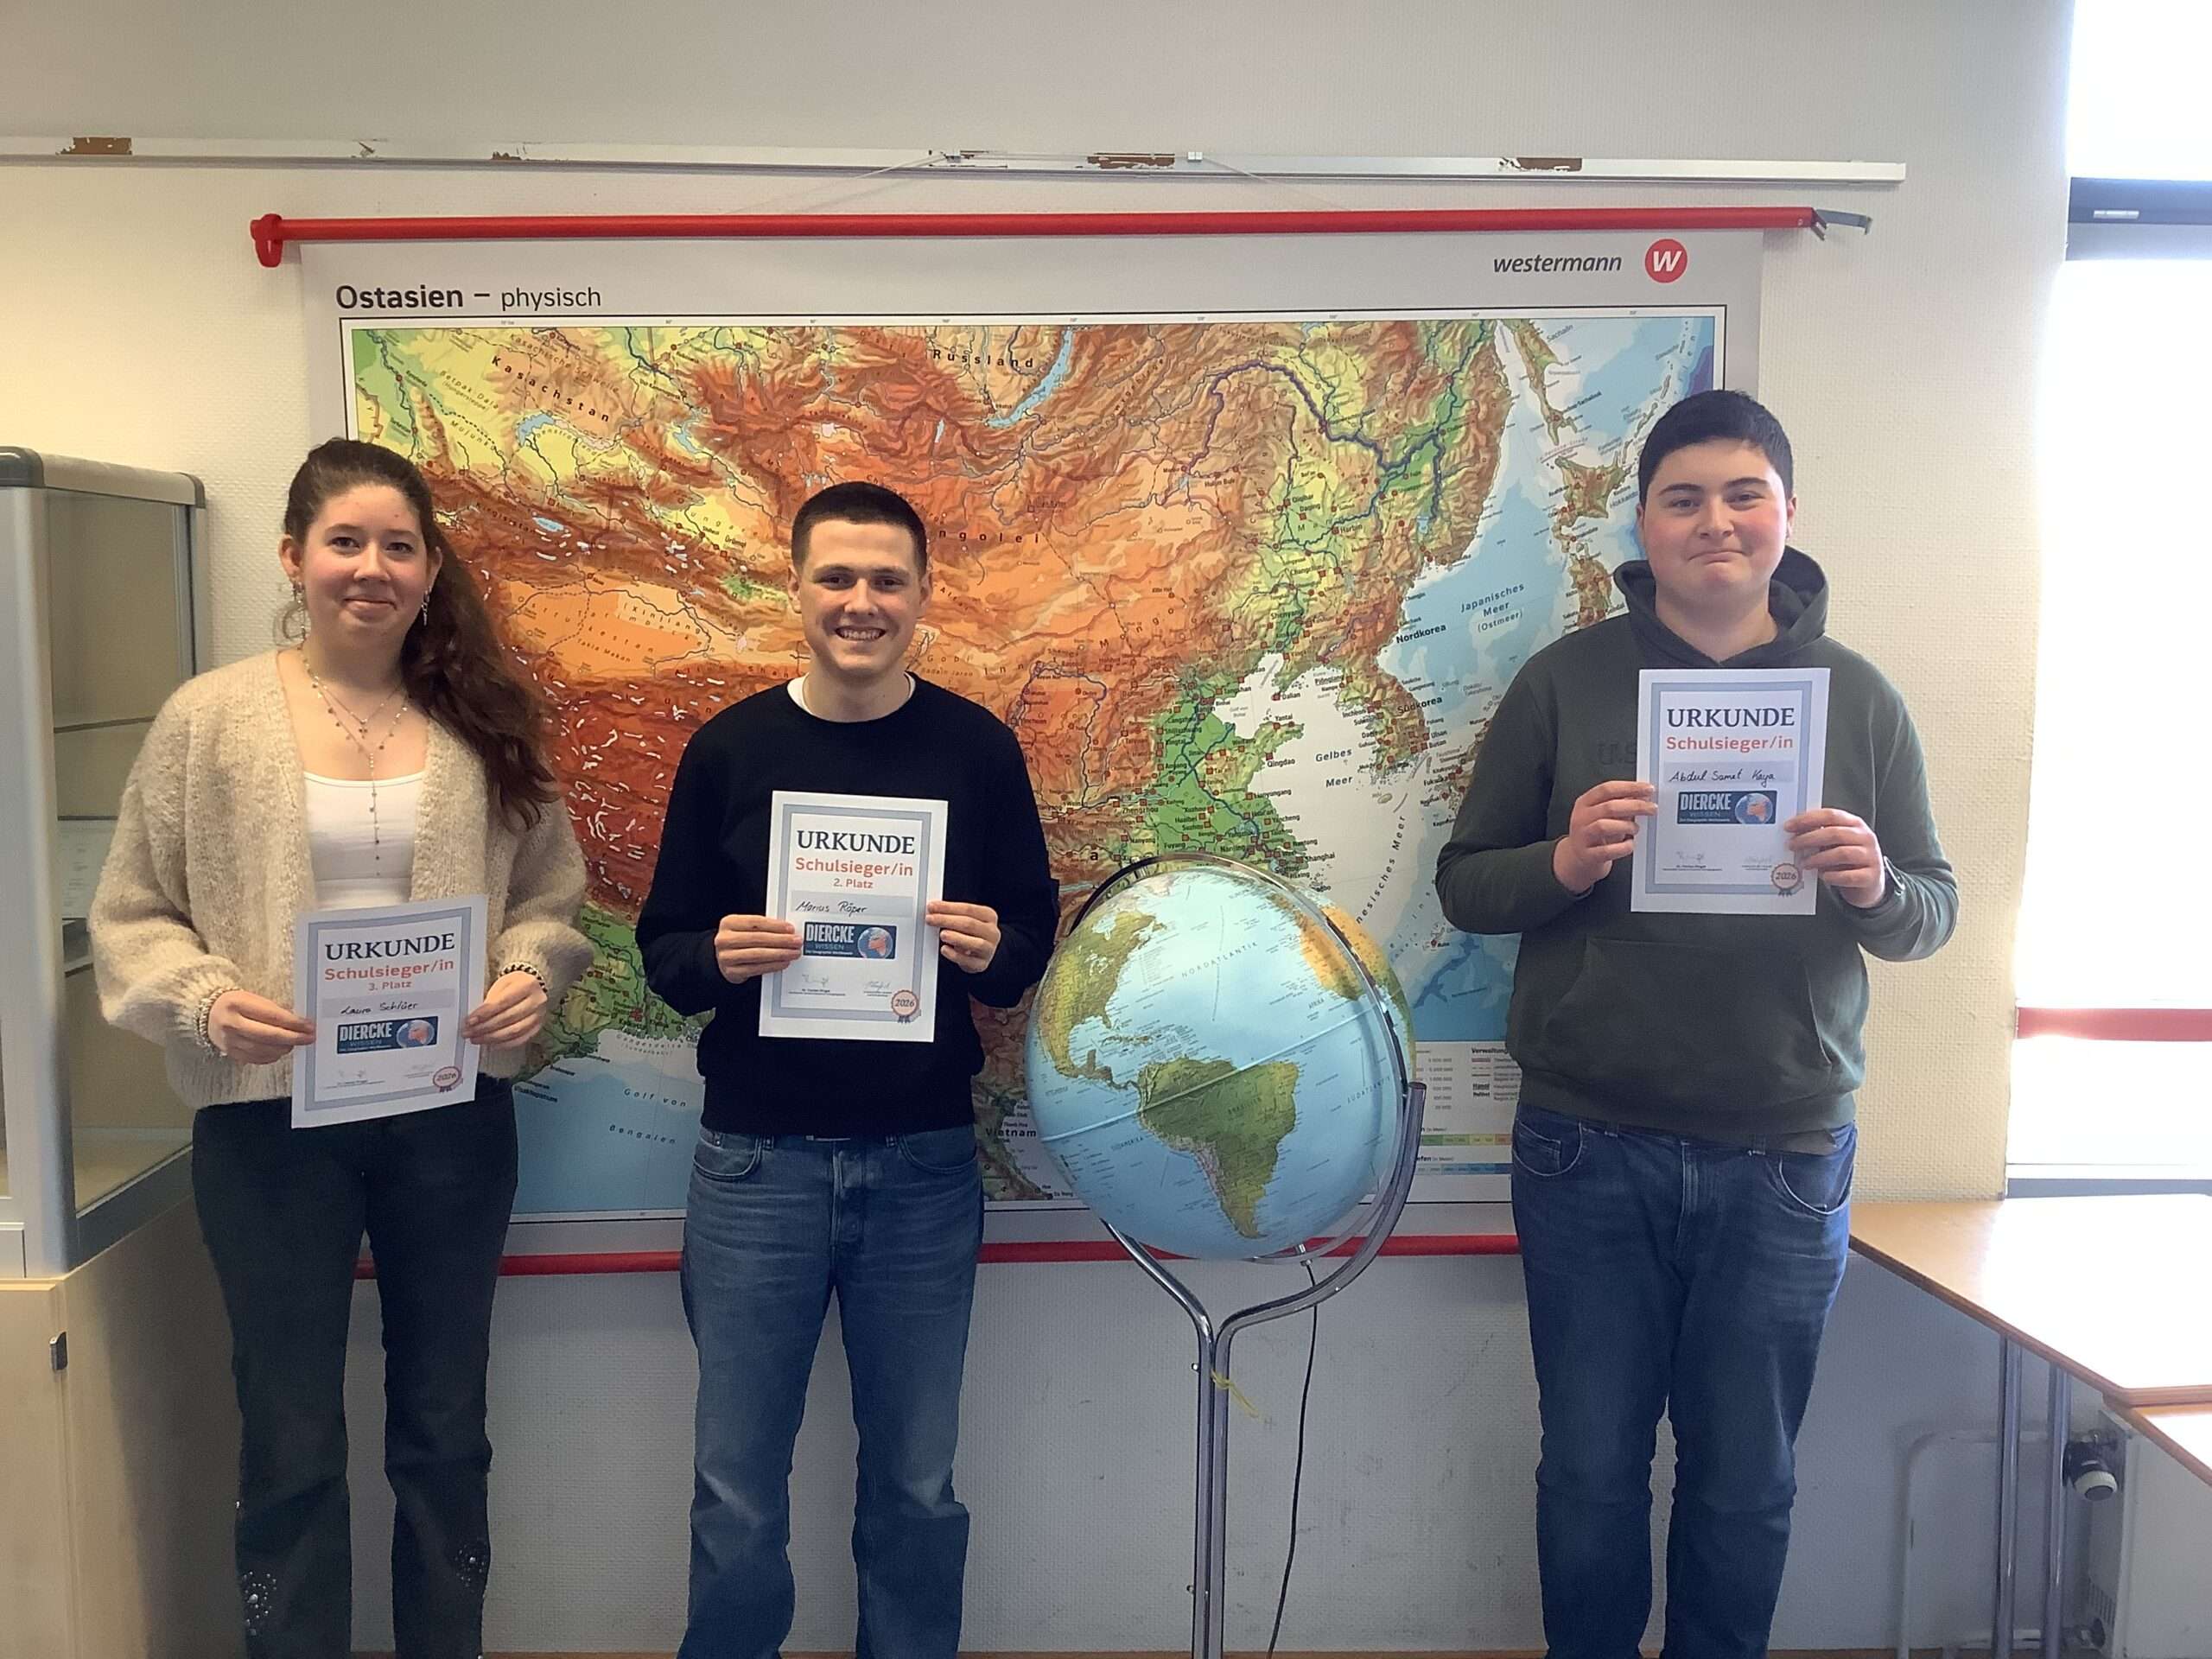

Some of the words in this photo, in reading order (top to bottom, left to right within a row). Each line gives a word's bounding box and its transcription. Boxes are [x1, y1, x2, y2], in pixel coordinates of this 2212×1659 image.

[1493, 253, 1622, 272] westermann
[336, 284, 463, 308] Ostasien
[501, 286, 601, 311] physisch
[1547, 325, 1573, 342] Sachalin
[933, 349, 1033, 368] Russland
[492, 355, 609, 422] Kasachstan
[938, 530, 1039, 543] ngolei
[1340, 524, 1363, 533] Harbin
[1461, 583, 1524, 613] Japanisches
[1484, 601, 1510, 617] Meer
[1478, 609, 1522, 632] (Ostmeer)
[1396, 624, 1446, 644] Nordkorea
[1397, 696, 1442, 715] Südkorea
[1667, 708, 1795, 728] URKUNDE
[1666, 735, 1794, 753] Schulsieger/in
[1267, 759, 1295, 768] Qingdao
[1315, 748, 1352, 762] Gelbes
[1325, 776, 1353, 788] Meer
[1669, 770, 1707, 783] Abdul
[1752, 769, 1776, 788] Kaya
[1680, 793, 1731, 810] DIERCKE
[797, 830, 915, 855] URKUNDE
[1392, 816, 1405, 850] Meer
[1304, 853, 1335, 862] Shanghai
[795, 857, 913, 878] Schulsieger/in
[833, 878, 843, 887] 2.
[845, 879, 874, 889] Platz
[1356, 858, 1395, 924] nesisches
[838, 900, 868, 917] Röper
[806, 924, 855, 943] DIERCKE
[325, 933, 455, 961] URKUNDE
[324, 959, 454, 981] Schulsieger/in
[368, 982, 378, 991] 3.
[382, 981, 412, 990] Platz
[894, 999, 915, 1007] 2026
[340, 1022, 393, 1041] DIERCKE
[624, 1088, 654, 1100] Golf
[663, 1096, 686, 1107] von
[609, 1124, 676, 1144] Bengalen
[986, 1128, 1037, 1137] Vietnam
